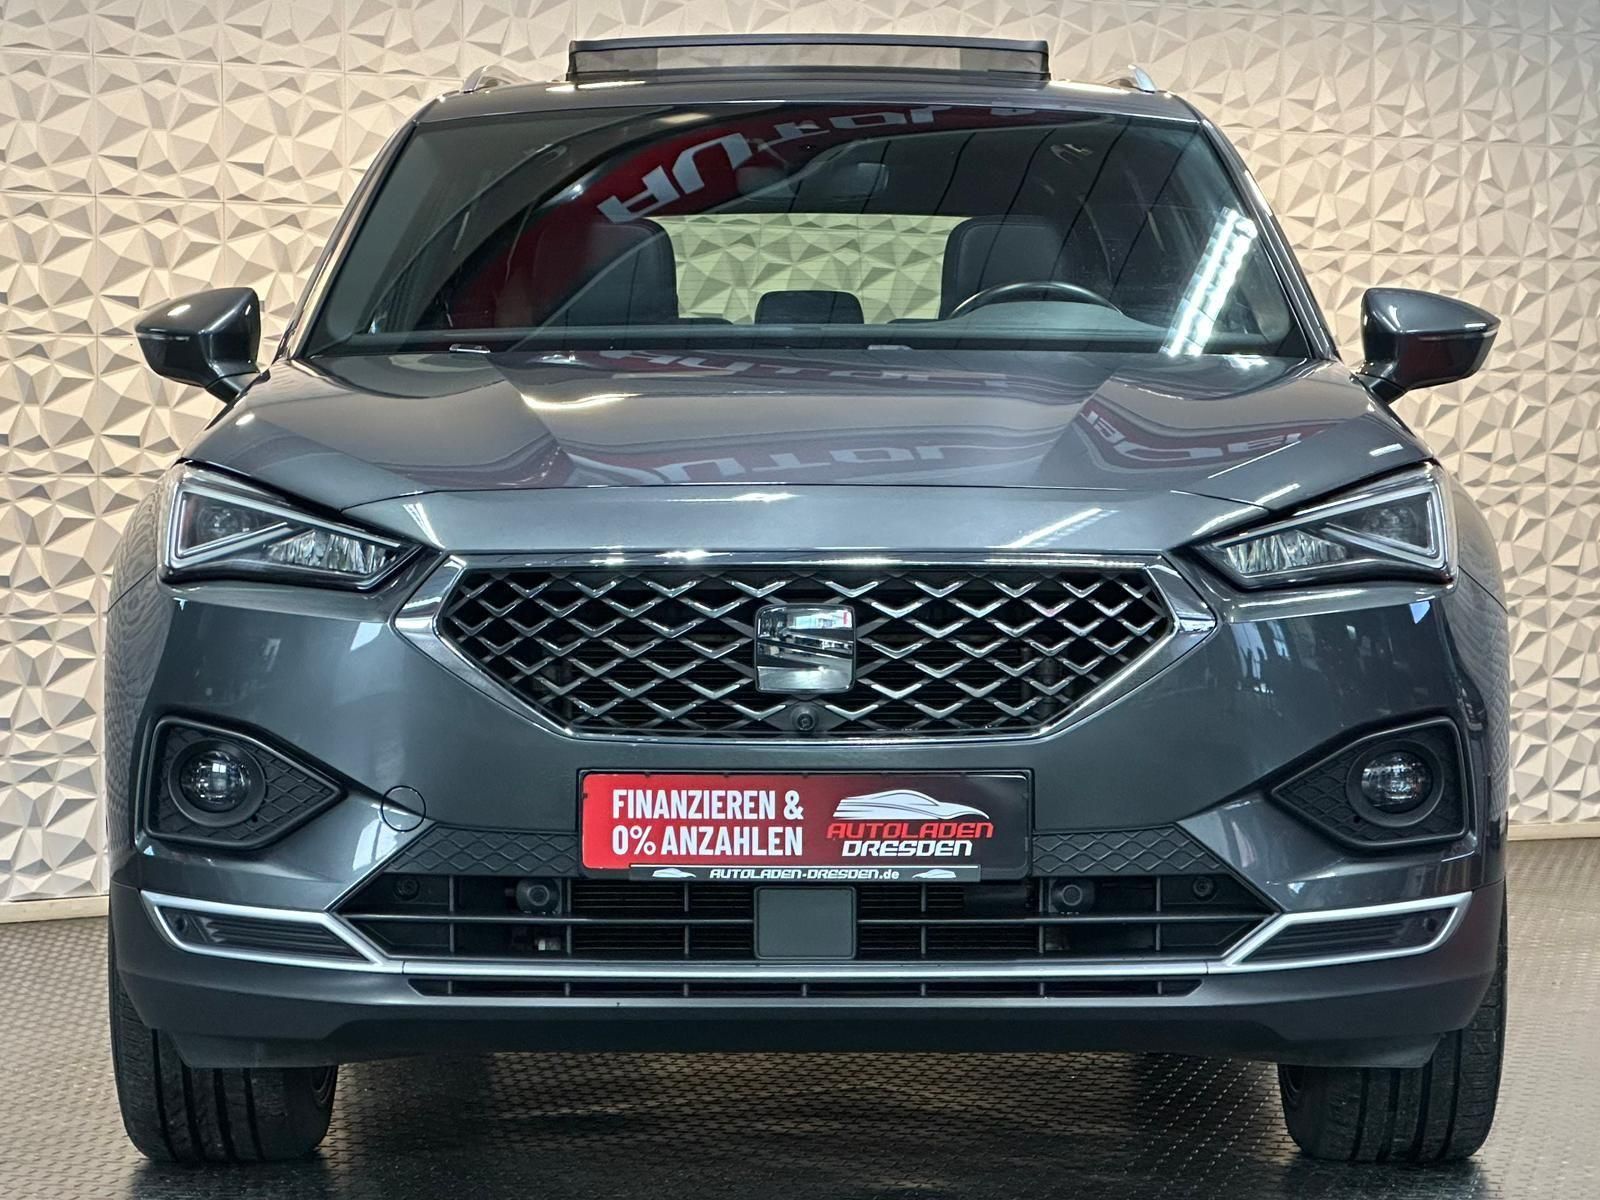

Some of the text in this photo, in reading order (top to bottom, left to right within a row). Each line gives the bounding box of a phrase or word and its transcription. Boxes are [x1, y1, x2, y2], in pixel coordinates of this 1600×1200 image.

[612, 789, 804, 820] FINANZIEREN &
[612, 825, 803, 856] 0% ANZAHLEN
[826, 822, 994, 839] AUTOLADEN
[842, 840, 973, 857] DRESDEN
